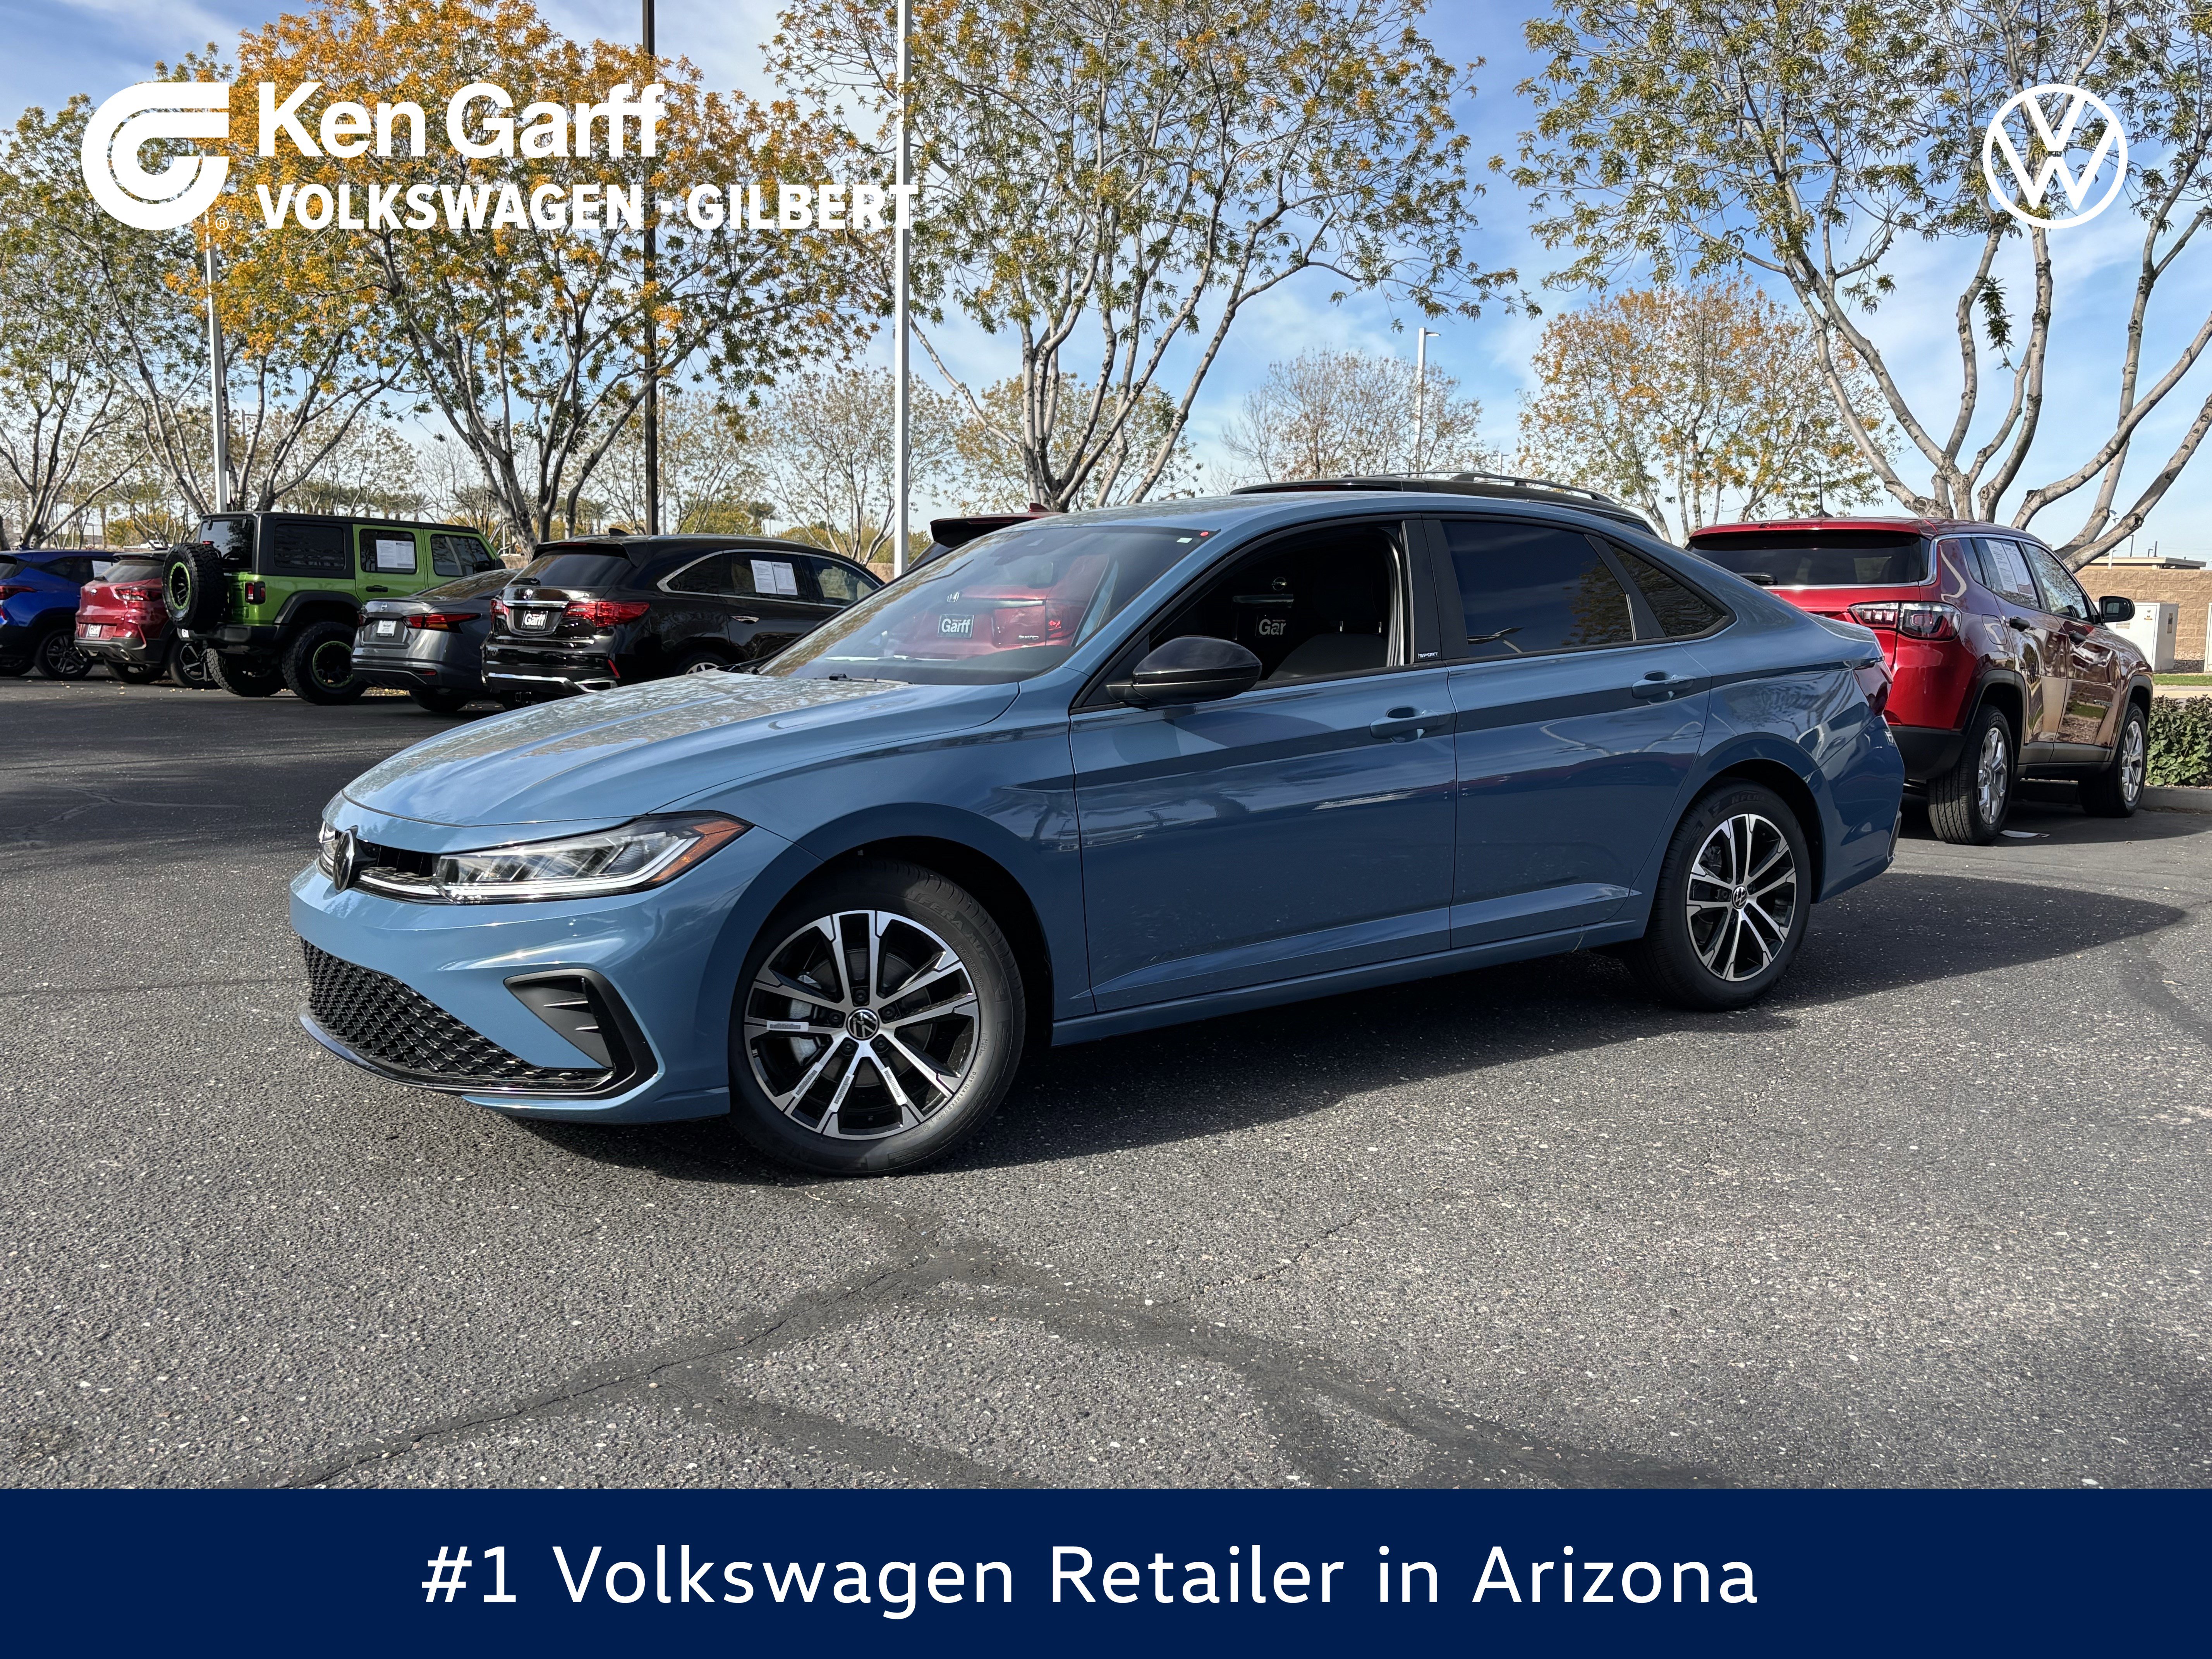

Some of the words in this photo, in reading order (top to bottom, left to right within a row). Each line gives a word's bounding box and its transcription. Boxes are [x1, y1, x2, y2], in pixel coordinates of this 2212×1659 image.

[524, 613, 546, 626] Garff
[941, 618, 971, 633] Garff
[968, 1071, 977, 1082] DOT
